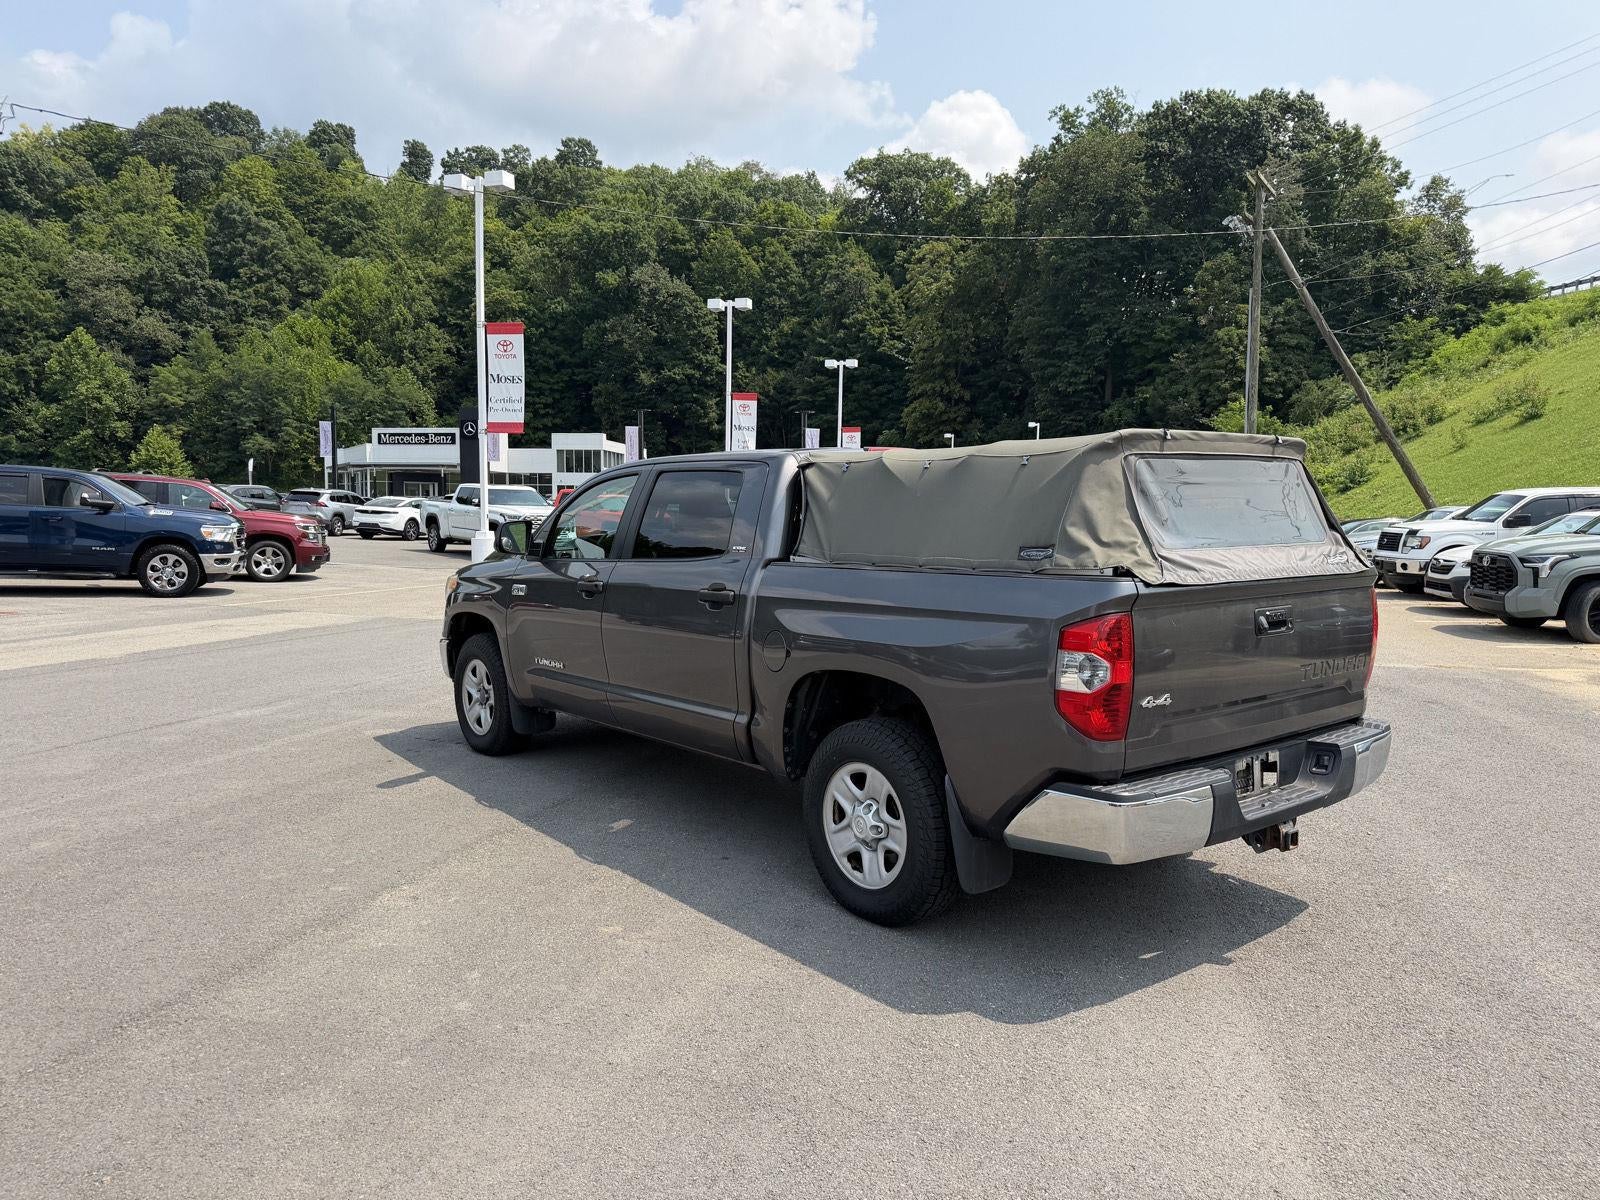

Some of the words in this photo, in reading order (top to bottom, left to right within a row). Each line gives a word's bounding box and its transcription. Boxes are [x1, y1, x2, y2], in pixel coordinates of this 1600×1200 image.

[489, 395, 523, 404] Certified
[380, 433, 453, 444] Mercedes-Benz
[534, 656, 565, 669] TUNDRA
[1300, 653, 1367, 681] TUNDRA
[1141, 693, 1172, 708] 4x4
